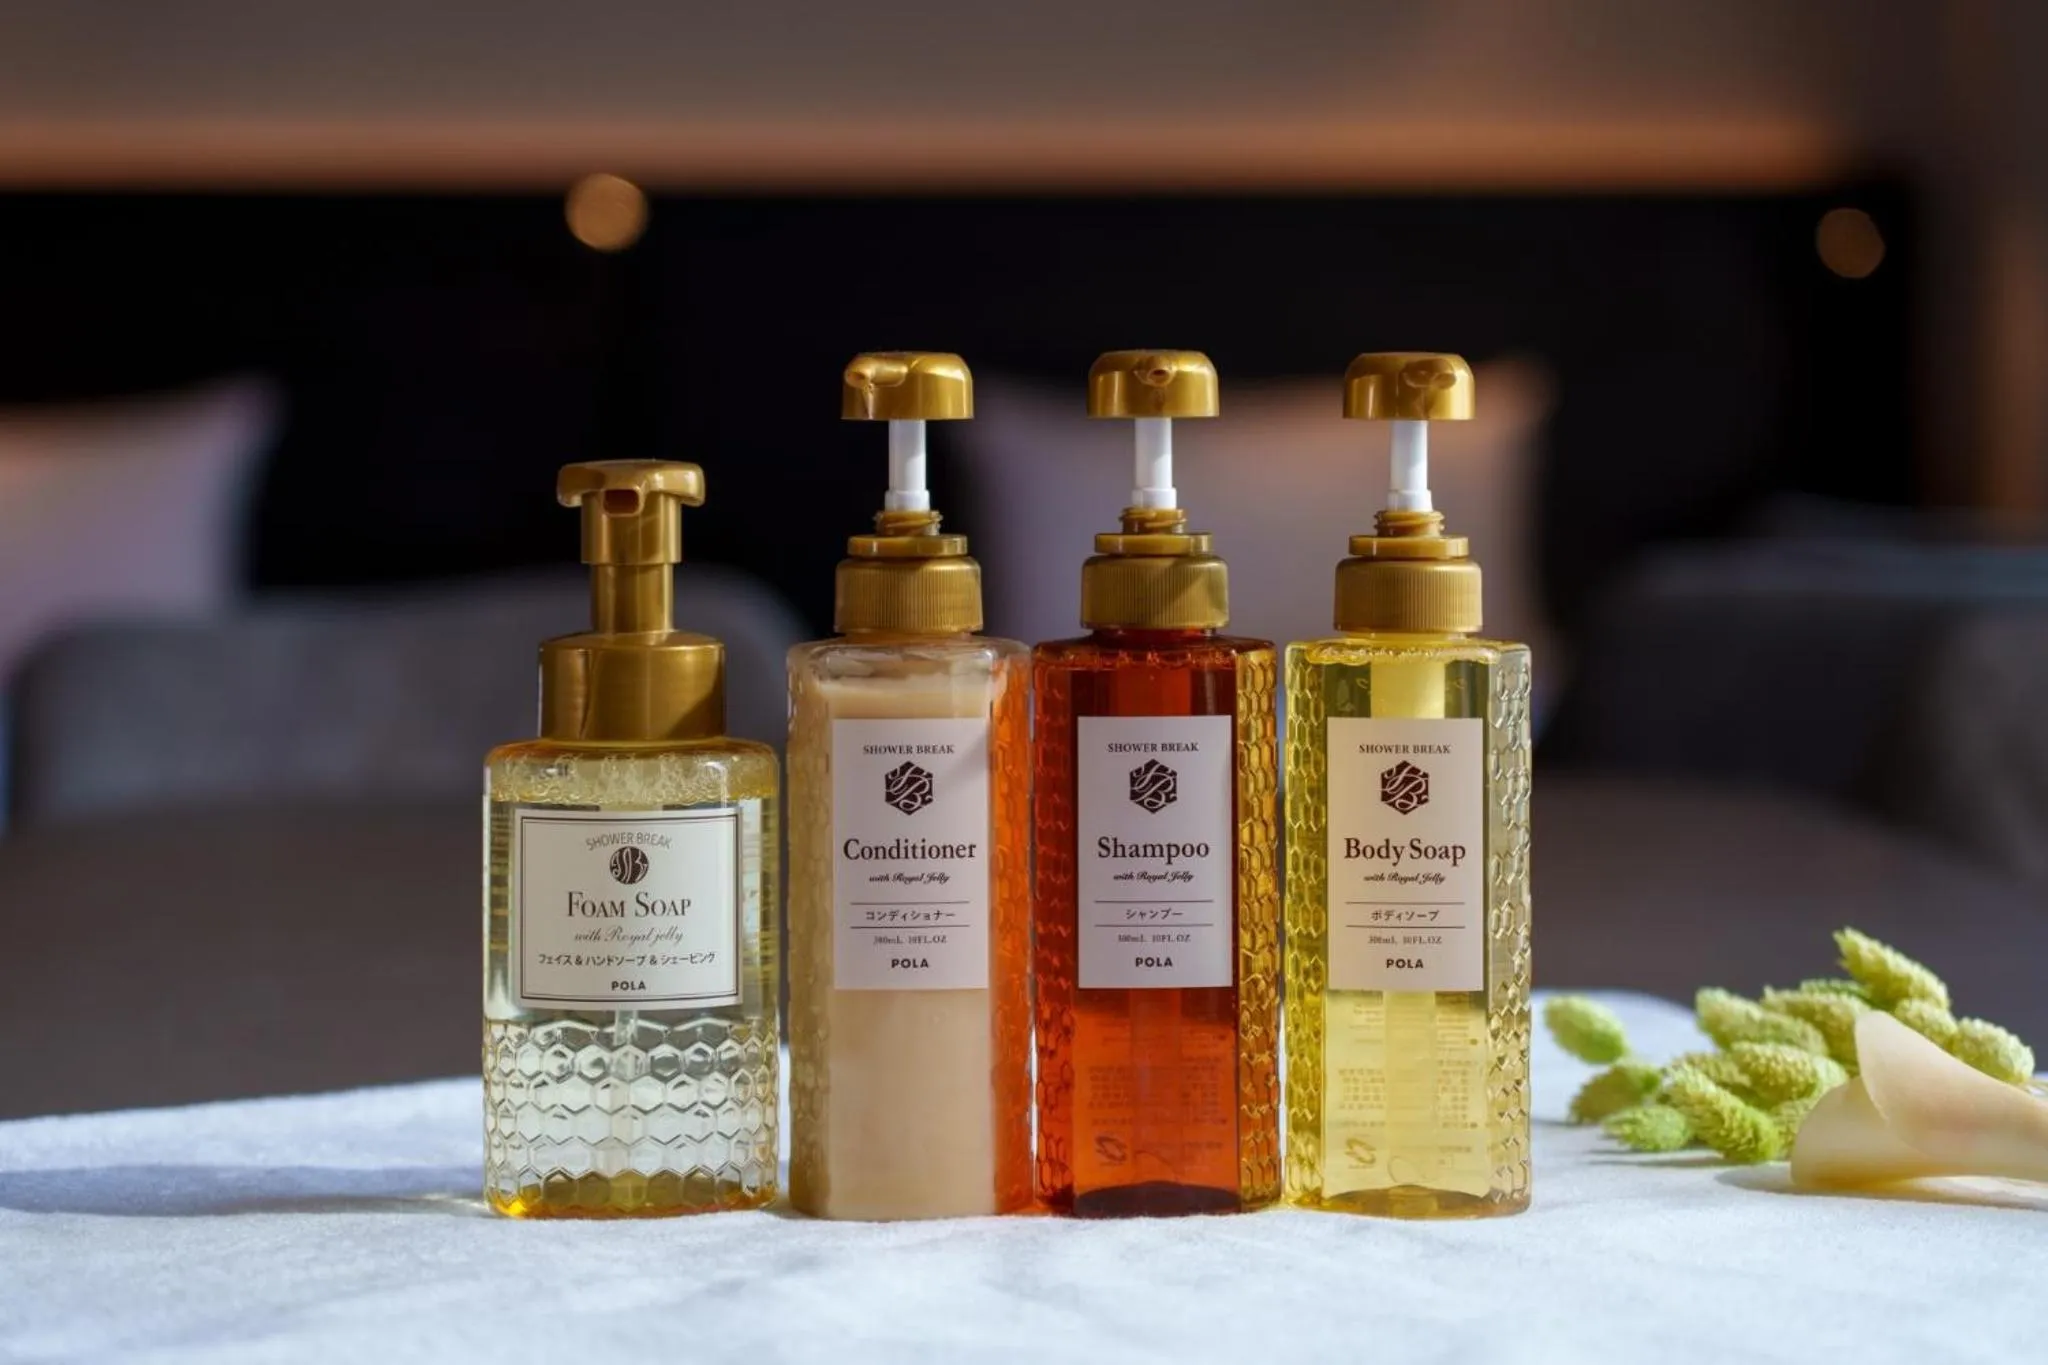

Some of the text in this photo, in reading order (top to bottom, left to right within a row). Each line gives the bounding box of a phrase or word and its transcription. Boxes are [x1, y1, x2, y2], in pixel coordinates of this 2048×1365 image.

[863, 745, 955, 754] SHOWER BREAK
[1107, 743, 1199, 752] SHOWER BREAK
[1359, 744, 1451, 754] SHOWER BREAK
[585, 832, 673, 851] SHOWER BREAK
[843, 838, 977, 860] Conditioner
[1097, 836, 1210, 865] Shampoo
[1344, 837, 1466, 867] Body Soap
[868, 872, 950, 885] with Royal Jelly
[1113, 871, 1194, 884] with Royal Jelly
[1363, 872, 1446, 885] with Royal Jelly
[567, 891, 692, 918] FOAM SOAP
[866, 910, 956, 921] コンディショナー
[1126, 908, 1184, 920] シャンプー
[574, 924, 684, 948] with Royal jelly
[891, 958, 929, 969] POLA
[1135, 957, 1173, 968] POLA
[1386, 958, 1424, 969] POLA
[611, 980, 646, 991] POLA
